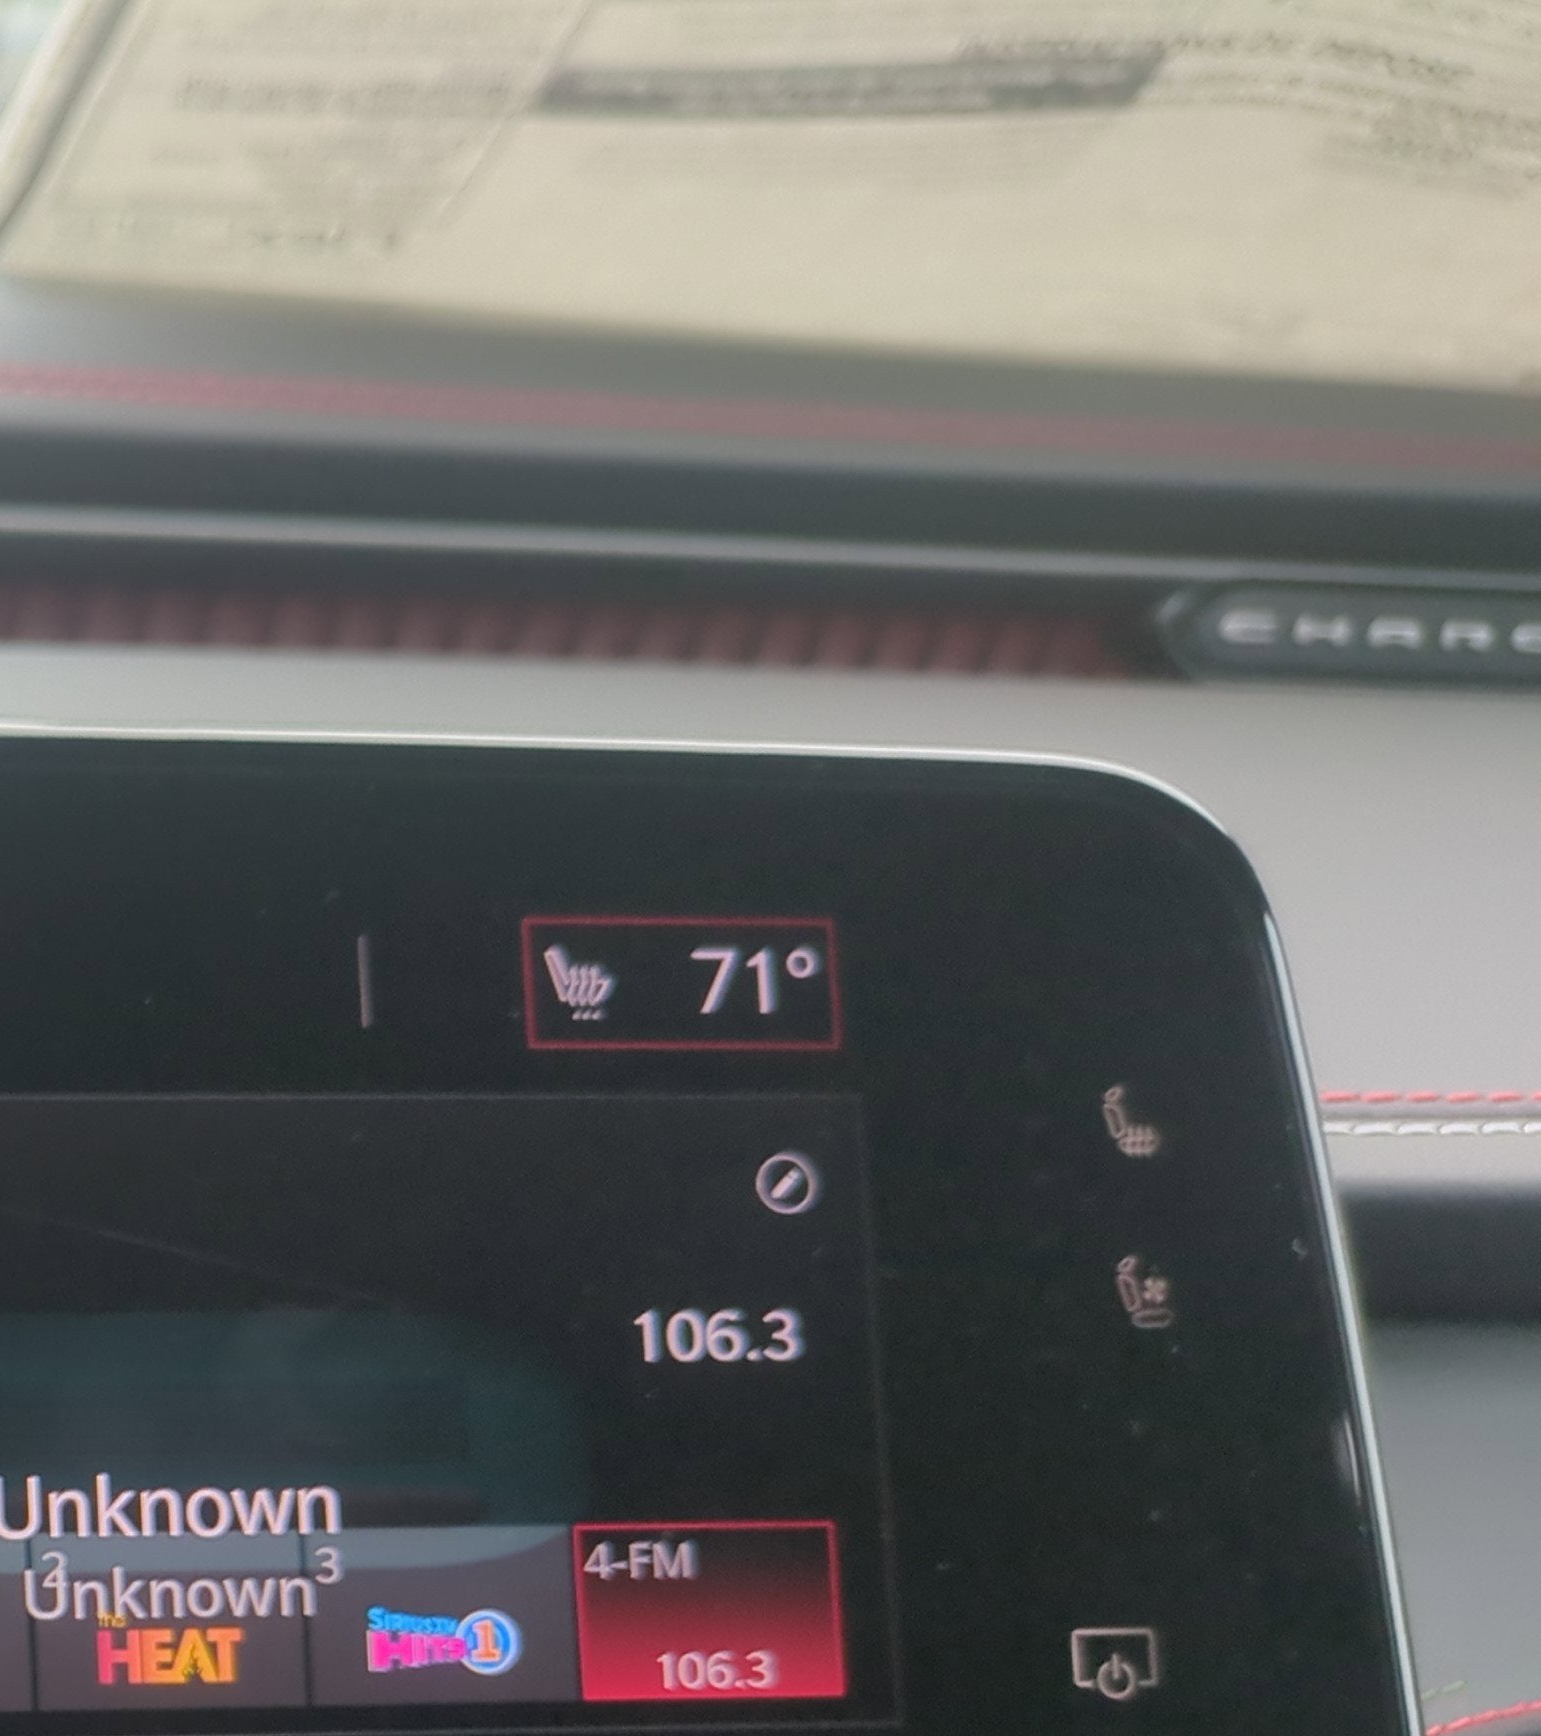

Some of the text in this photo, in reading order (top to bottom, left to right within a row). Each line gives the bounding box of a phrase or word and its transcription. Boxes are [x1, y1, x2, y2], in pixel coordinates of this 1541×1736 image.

[690, 945, 821, 1014] 71°
[633, 1308, 805, 1363] 106.3
[314, 1547, 343, 1585] 3
[583, 1540, 697, 1581] 4-FM
[23, 1566, 318, 1621] Unknown
[96, 1627, 245, 1685] HEAT
[656, 1650, 780, 1690] 106.3
